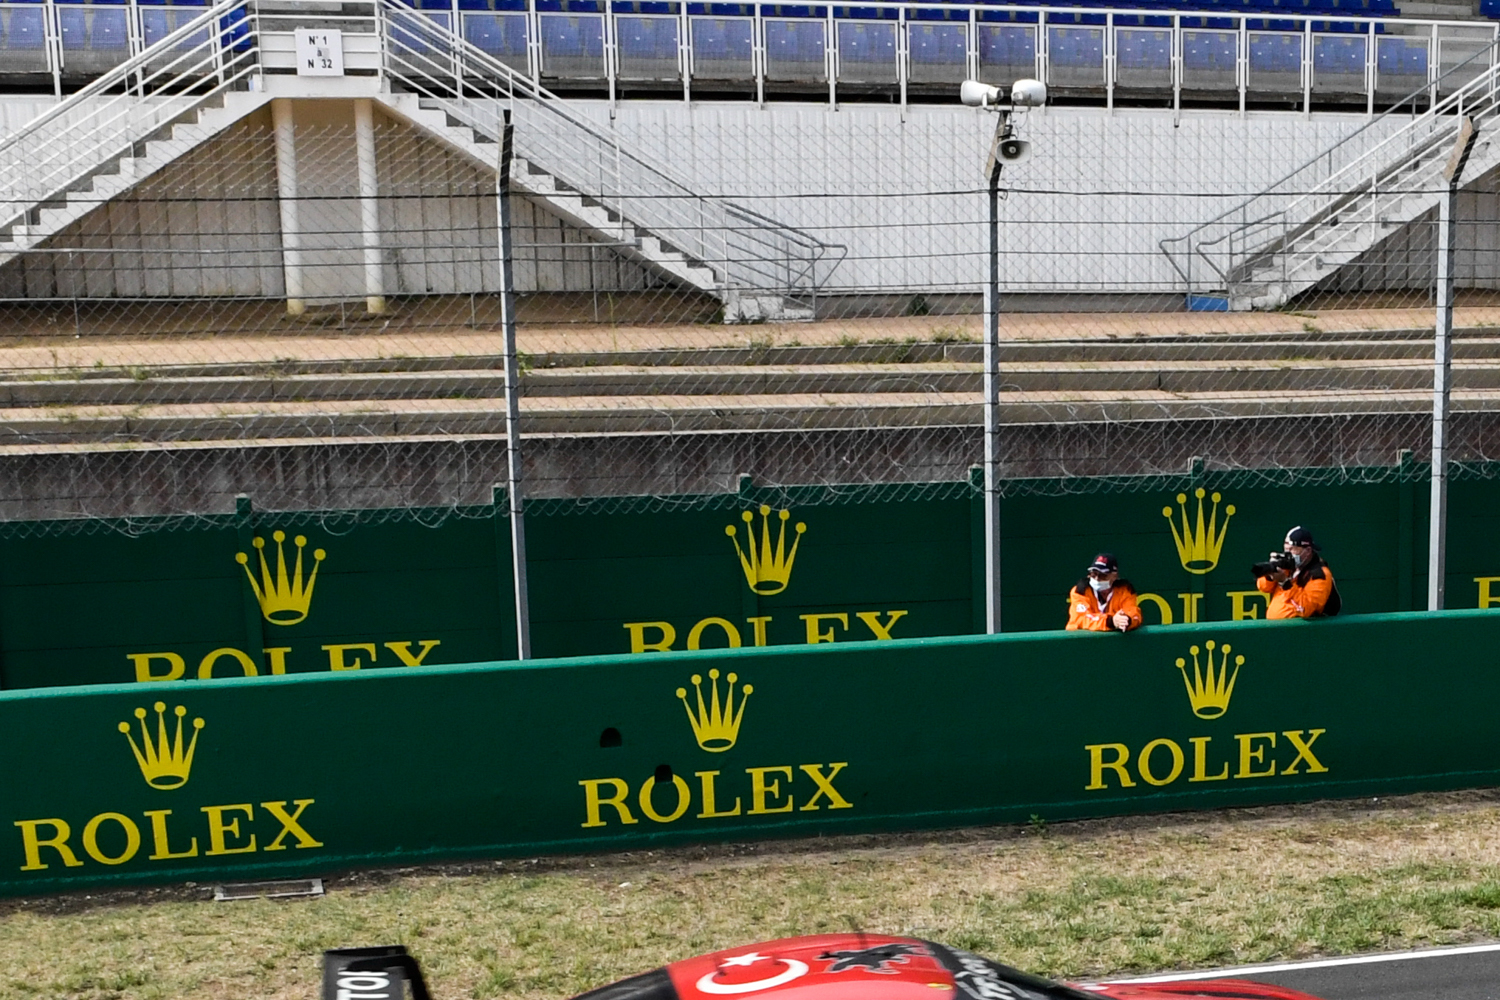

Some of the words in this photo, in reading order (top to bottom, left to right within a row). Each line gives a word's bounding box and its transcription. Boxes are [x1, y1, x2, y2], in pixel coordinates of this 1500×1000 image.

[321, 58, 333, 69] 32
[622, 610, 908, 655] ROLEX
[1084, 728, 1330, 791] ROLEX
[578, 761, 854, 828] ROLEX
[13, 798, 325, 871] ROLEX
